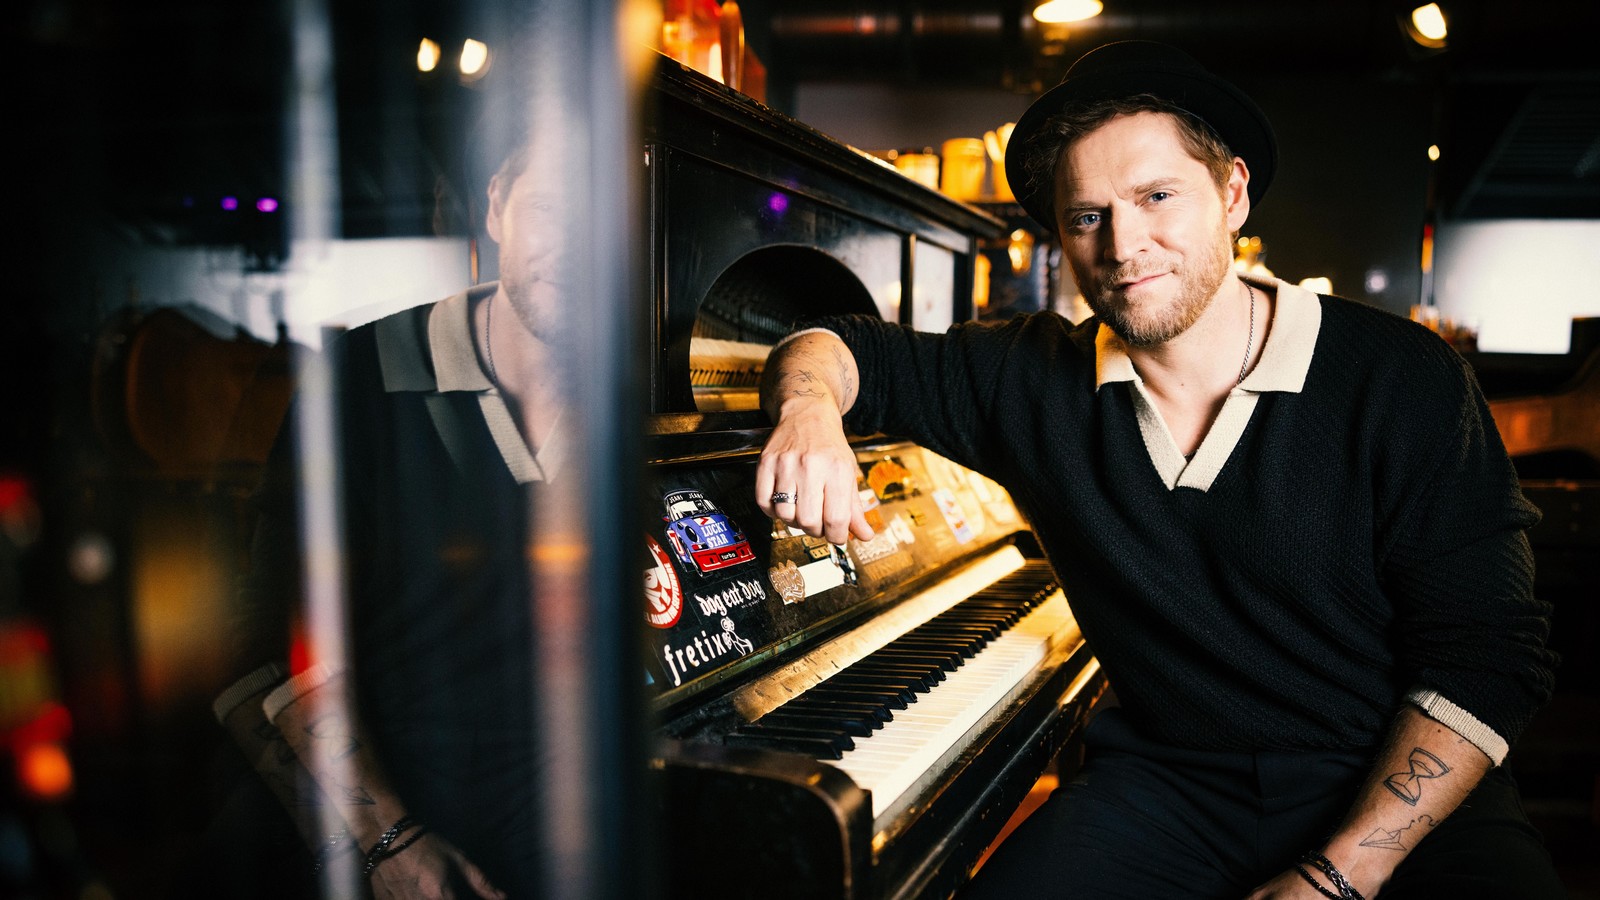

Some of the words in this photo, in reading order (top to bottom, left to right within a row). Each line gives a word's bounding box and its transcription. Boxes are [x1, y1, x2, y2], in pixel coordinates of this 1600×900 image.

[700, 521, 728, 538] LUCKY
[706, 533, 729, 548] STAR
[720, 552, 736, 560] turbo
[694, 593, 727, 617] dog
[721, 581, 744, 608] eat
[736, 578, 766, 600] dog
